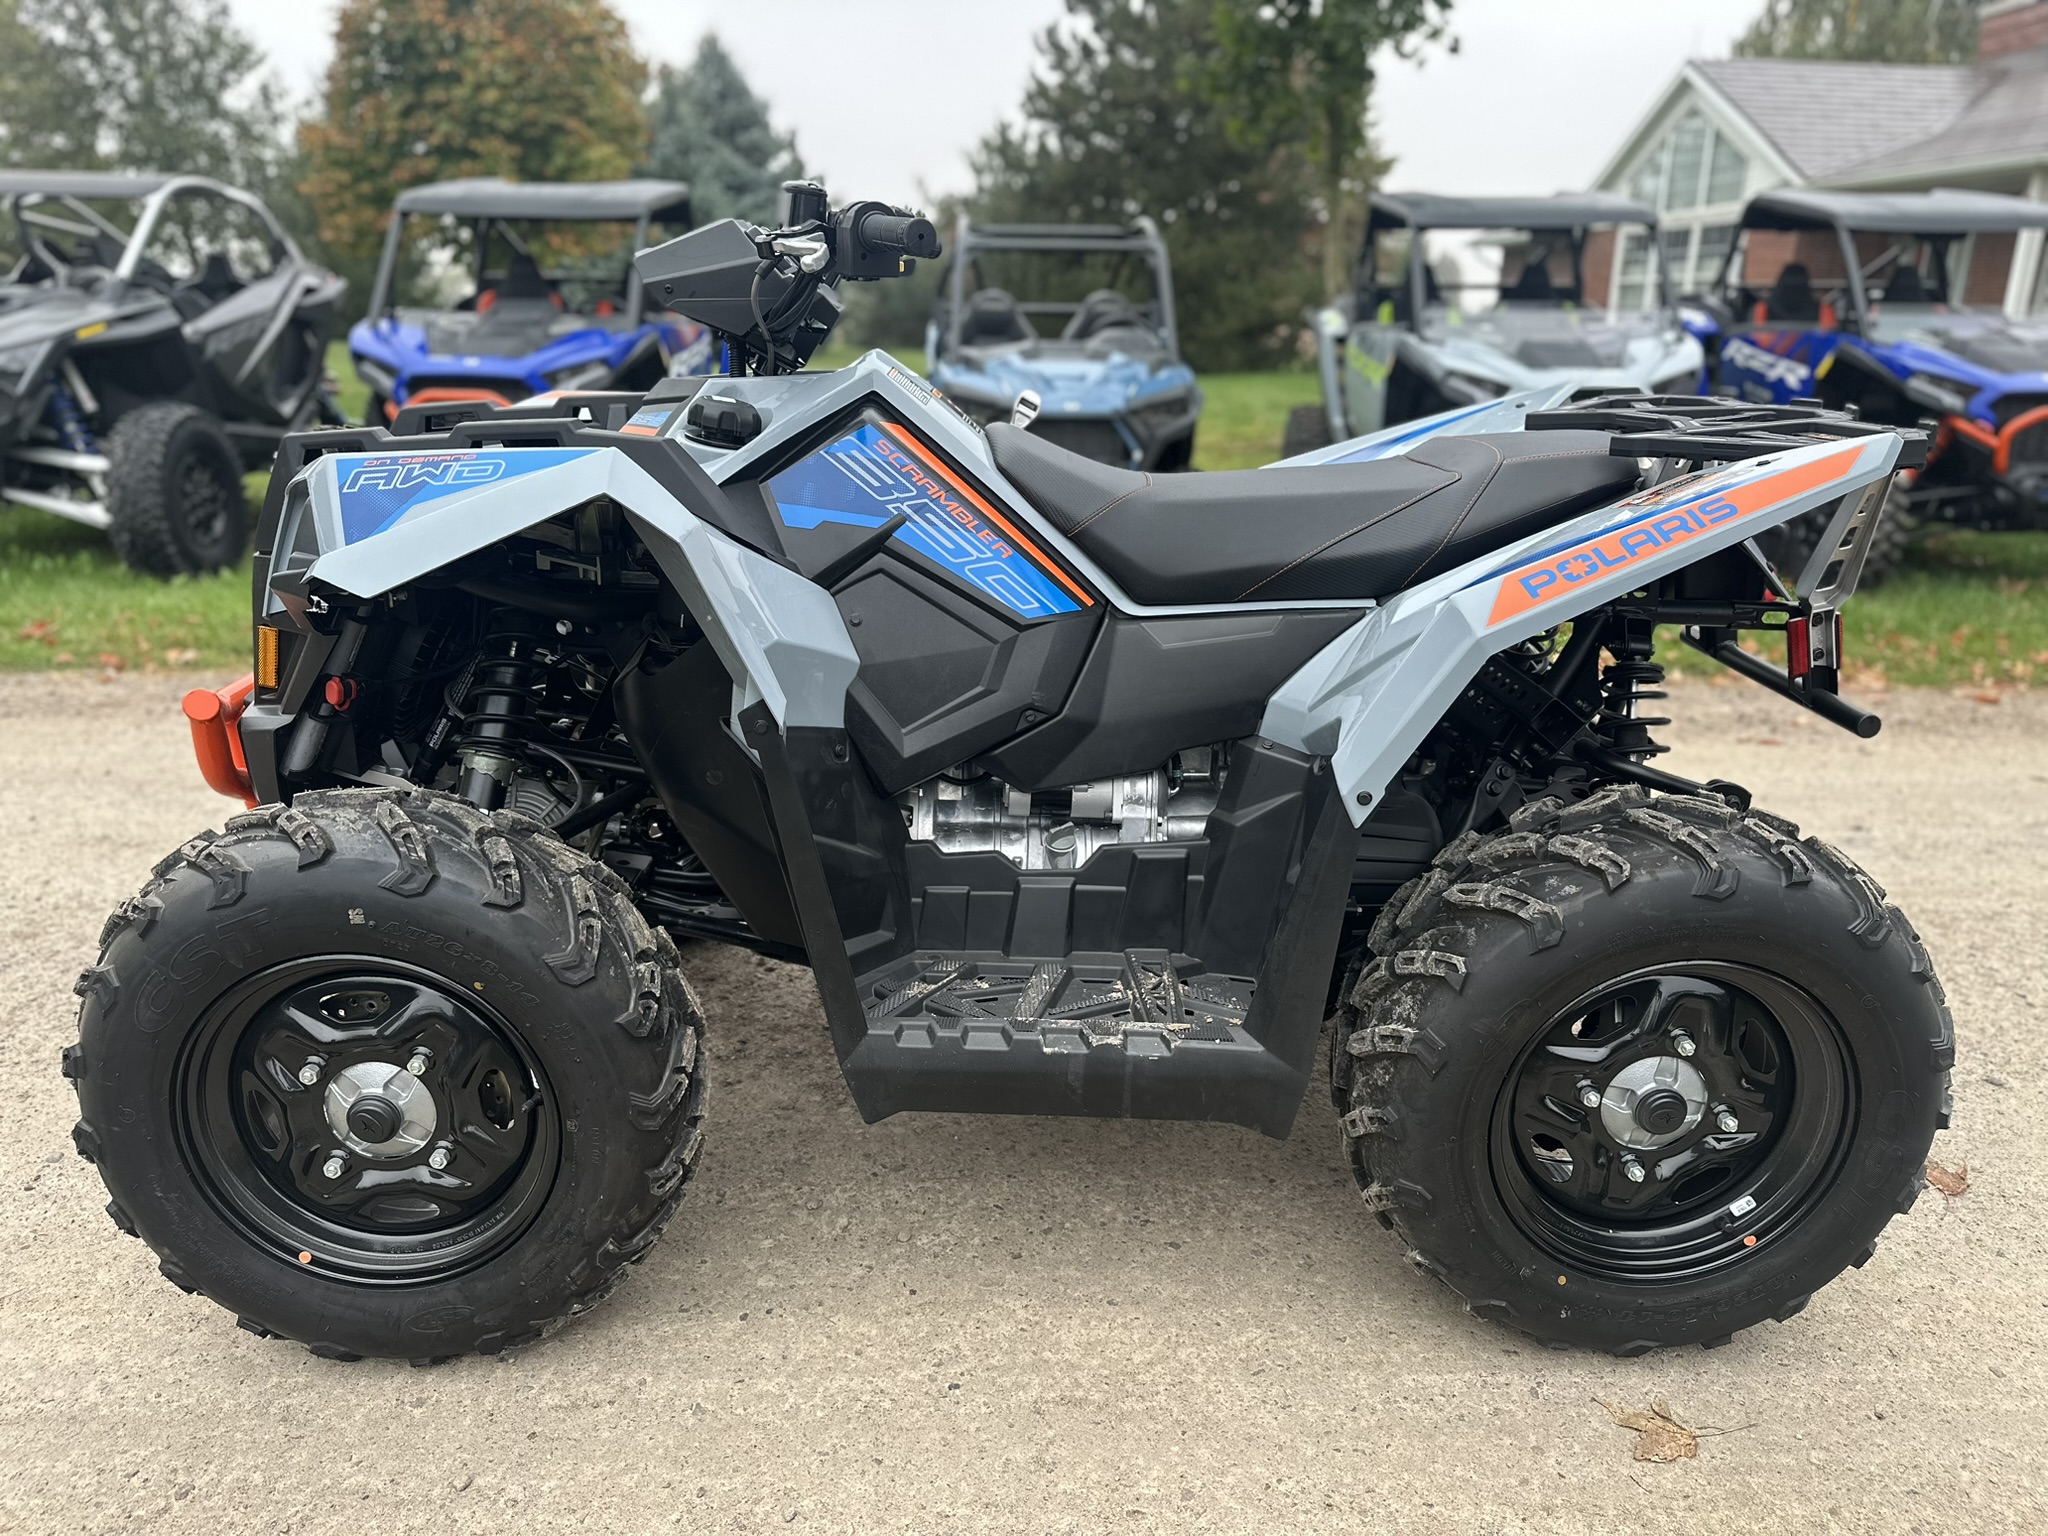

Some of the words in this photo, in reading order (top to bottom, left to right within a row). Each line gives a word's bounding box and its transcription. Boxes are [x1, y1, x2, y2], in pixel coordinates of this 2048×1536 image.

[341, 459, 506, 493] AWD
[363, 459, 391, 467] ON
[397, 453, 477, 465] DEMAND
[872, 438, 1013, 560] SCRAMBLER
[1518, 496, 1740, 600] POLARIS
[133, 907, 270, 1033] CST
